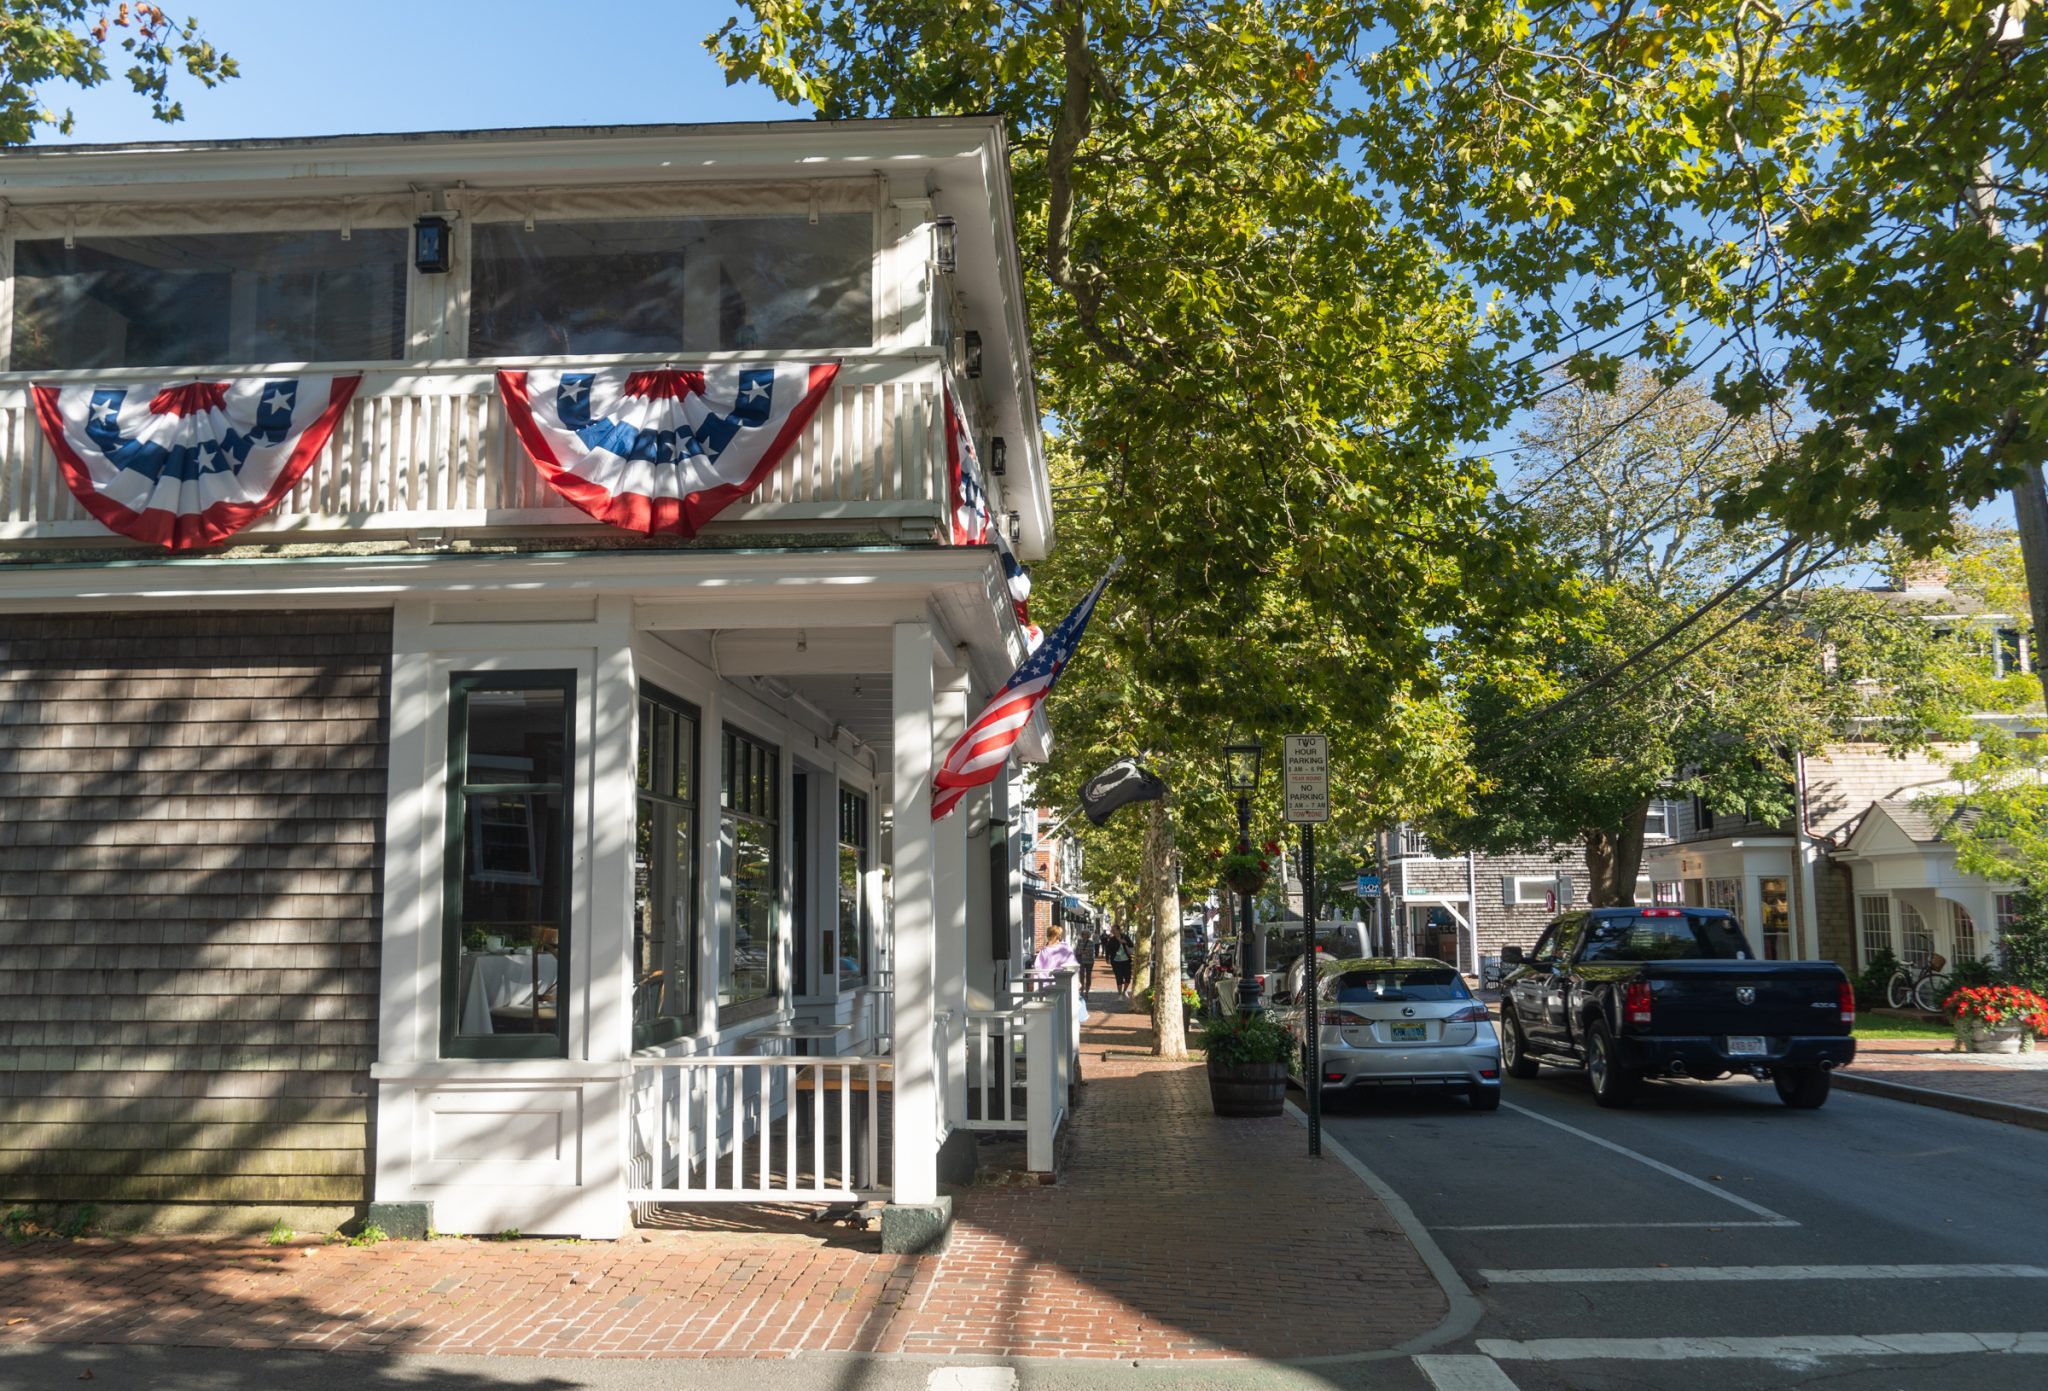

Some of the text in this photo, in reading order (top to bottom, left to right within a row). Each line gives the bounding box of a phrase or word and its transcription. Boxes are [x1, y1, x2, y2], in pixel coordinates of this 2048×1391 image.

[1297, 738, 1316, 746] TWO
[1300, 784, 1313, 792] NO
[1290, 793, 1325, 801] PARKING
